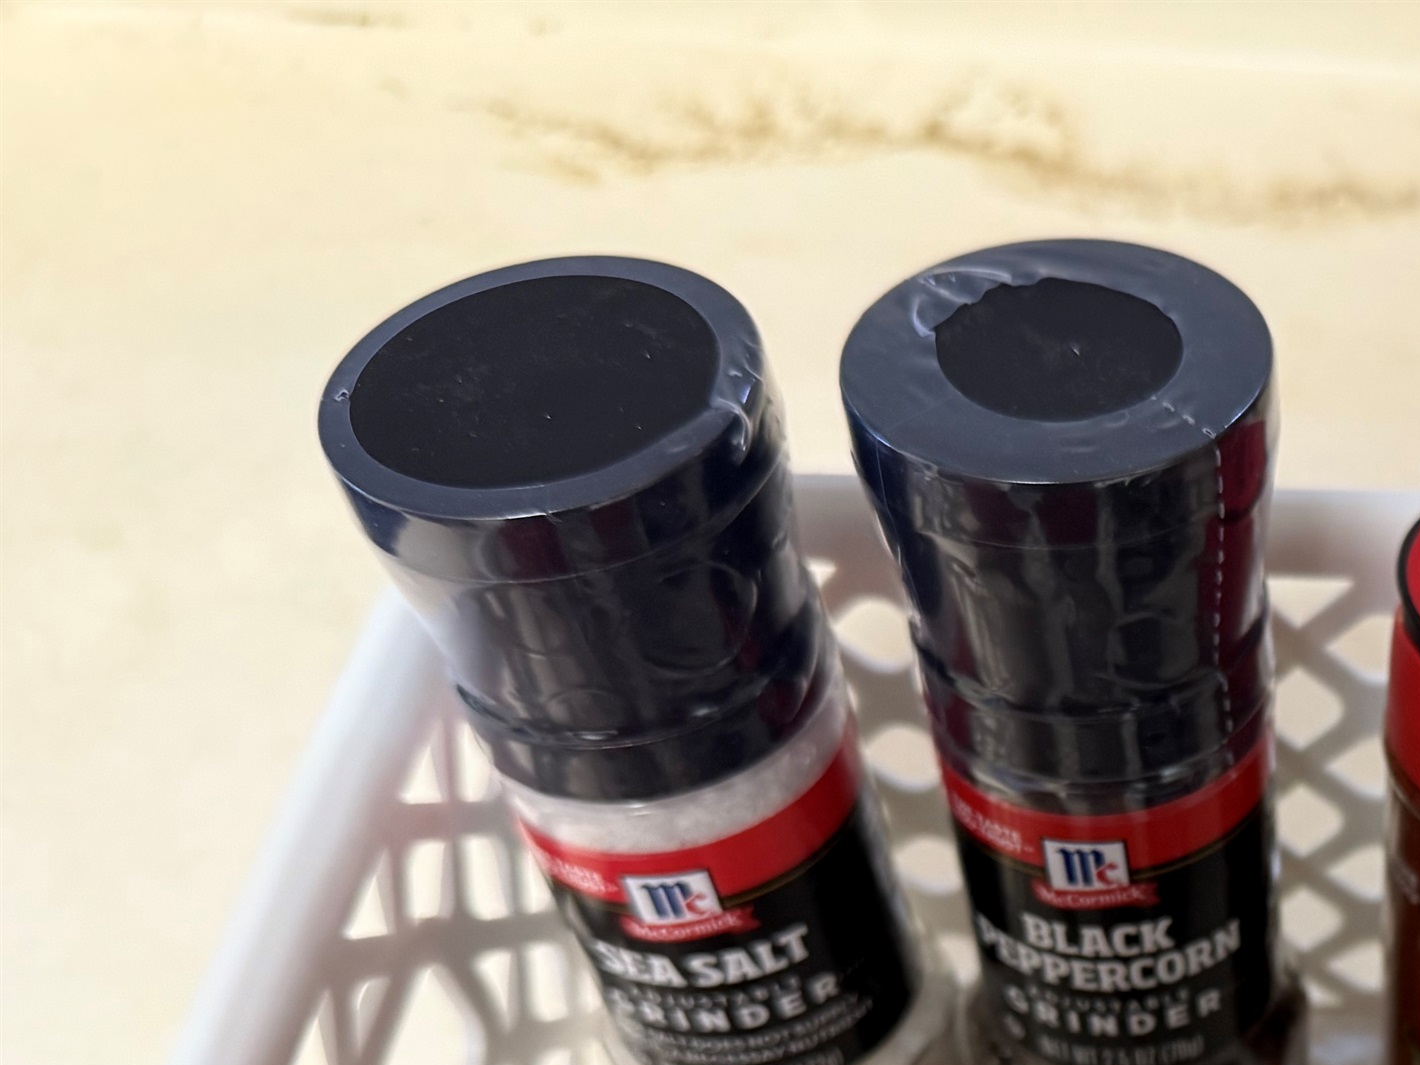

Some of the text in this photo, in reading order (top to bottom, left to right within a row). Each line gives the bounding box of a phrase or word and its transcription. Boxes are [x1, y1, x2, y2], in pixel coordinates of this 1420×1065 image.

[1041, 886, 1143, 907] McCormick
[634, 911, 741, 938] McCormick
[1021, 912, 1175, 958] BLACK
[594, 923, 810, 989] SEA SALT
[977, 912, 1241, 993] PEPPERCORN
[1003, 985, 1221, 1037] GRINDER
